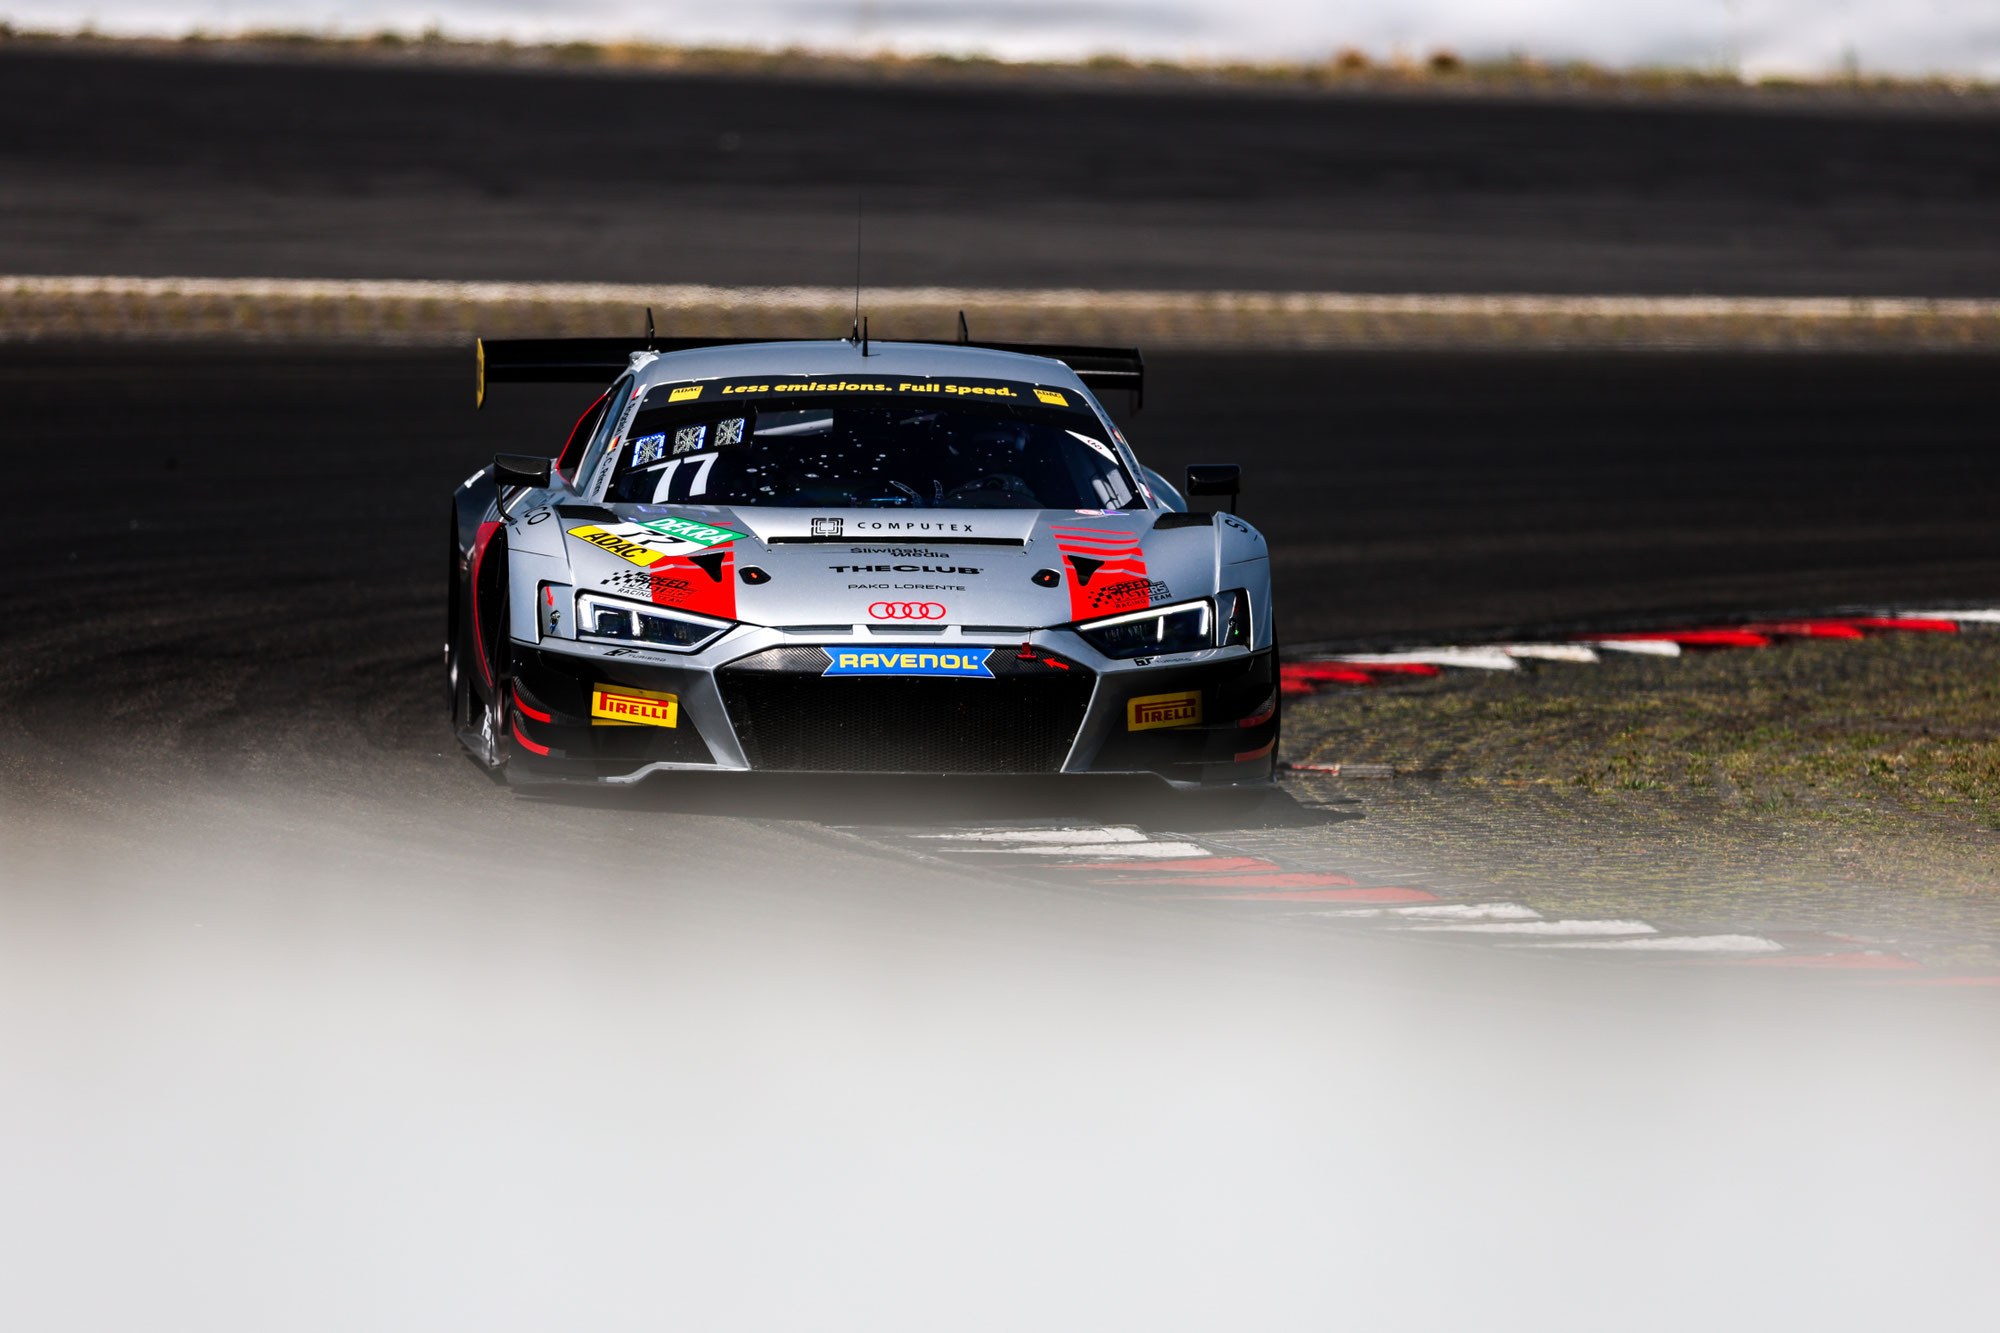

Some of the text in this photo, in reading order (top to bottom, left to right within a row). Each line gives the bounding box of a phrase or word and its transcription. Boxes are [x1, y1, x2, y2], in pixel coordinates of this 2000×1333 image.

[722, 382, 1018, 397] Less emissions. Full Speed.
[647, 452, 719, 504] 77
[650, 517, 733, 545] DEKRA
[857, 522, 973, 532] COMPUTEX
[583, 532, 648, 558] ADAC
[1107, 579, 1151, 596] SPEED
[1150, 592, 1173, 602] TEAM
[839, 653, 979, 669] RAVENOL
[600, 691, 669, 720] PIRELLI
[1135, 698, 1196, 724] PIRELLI
